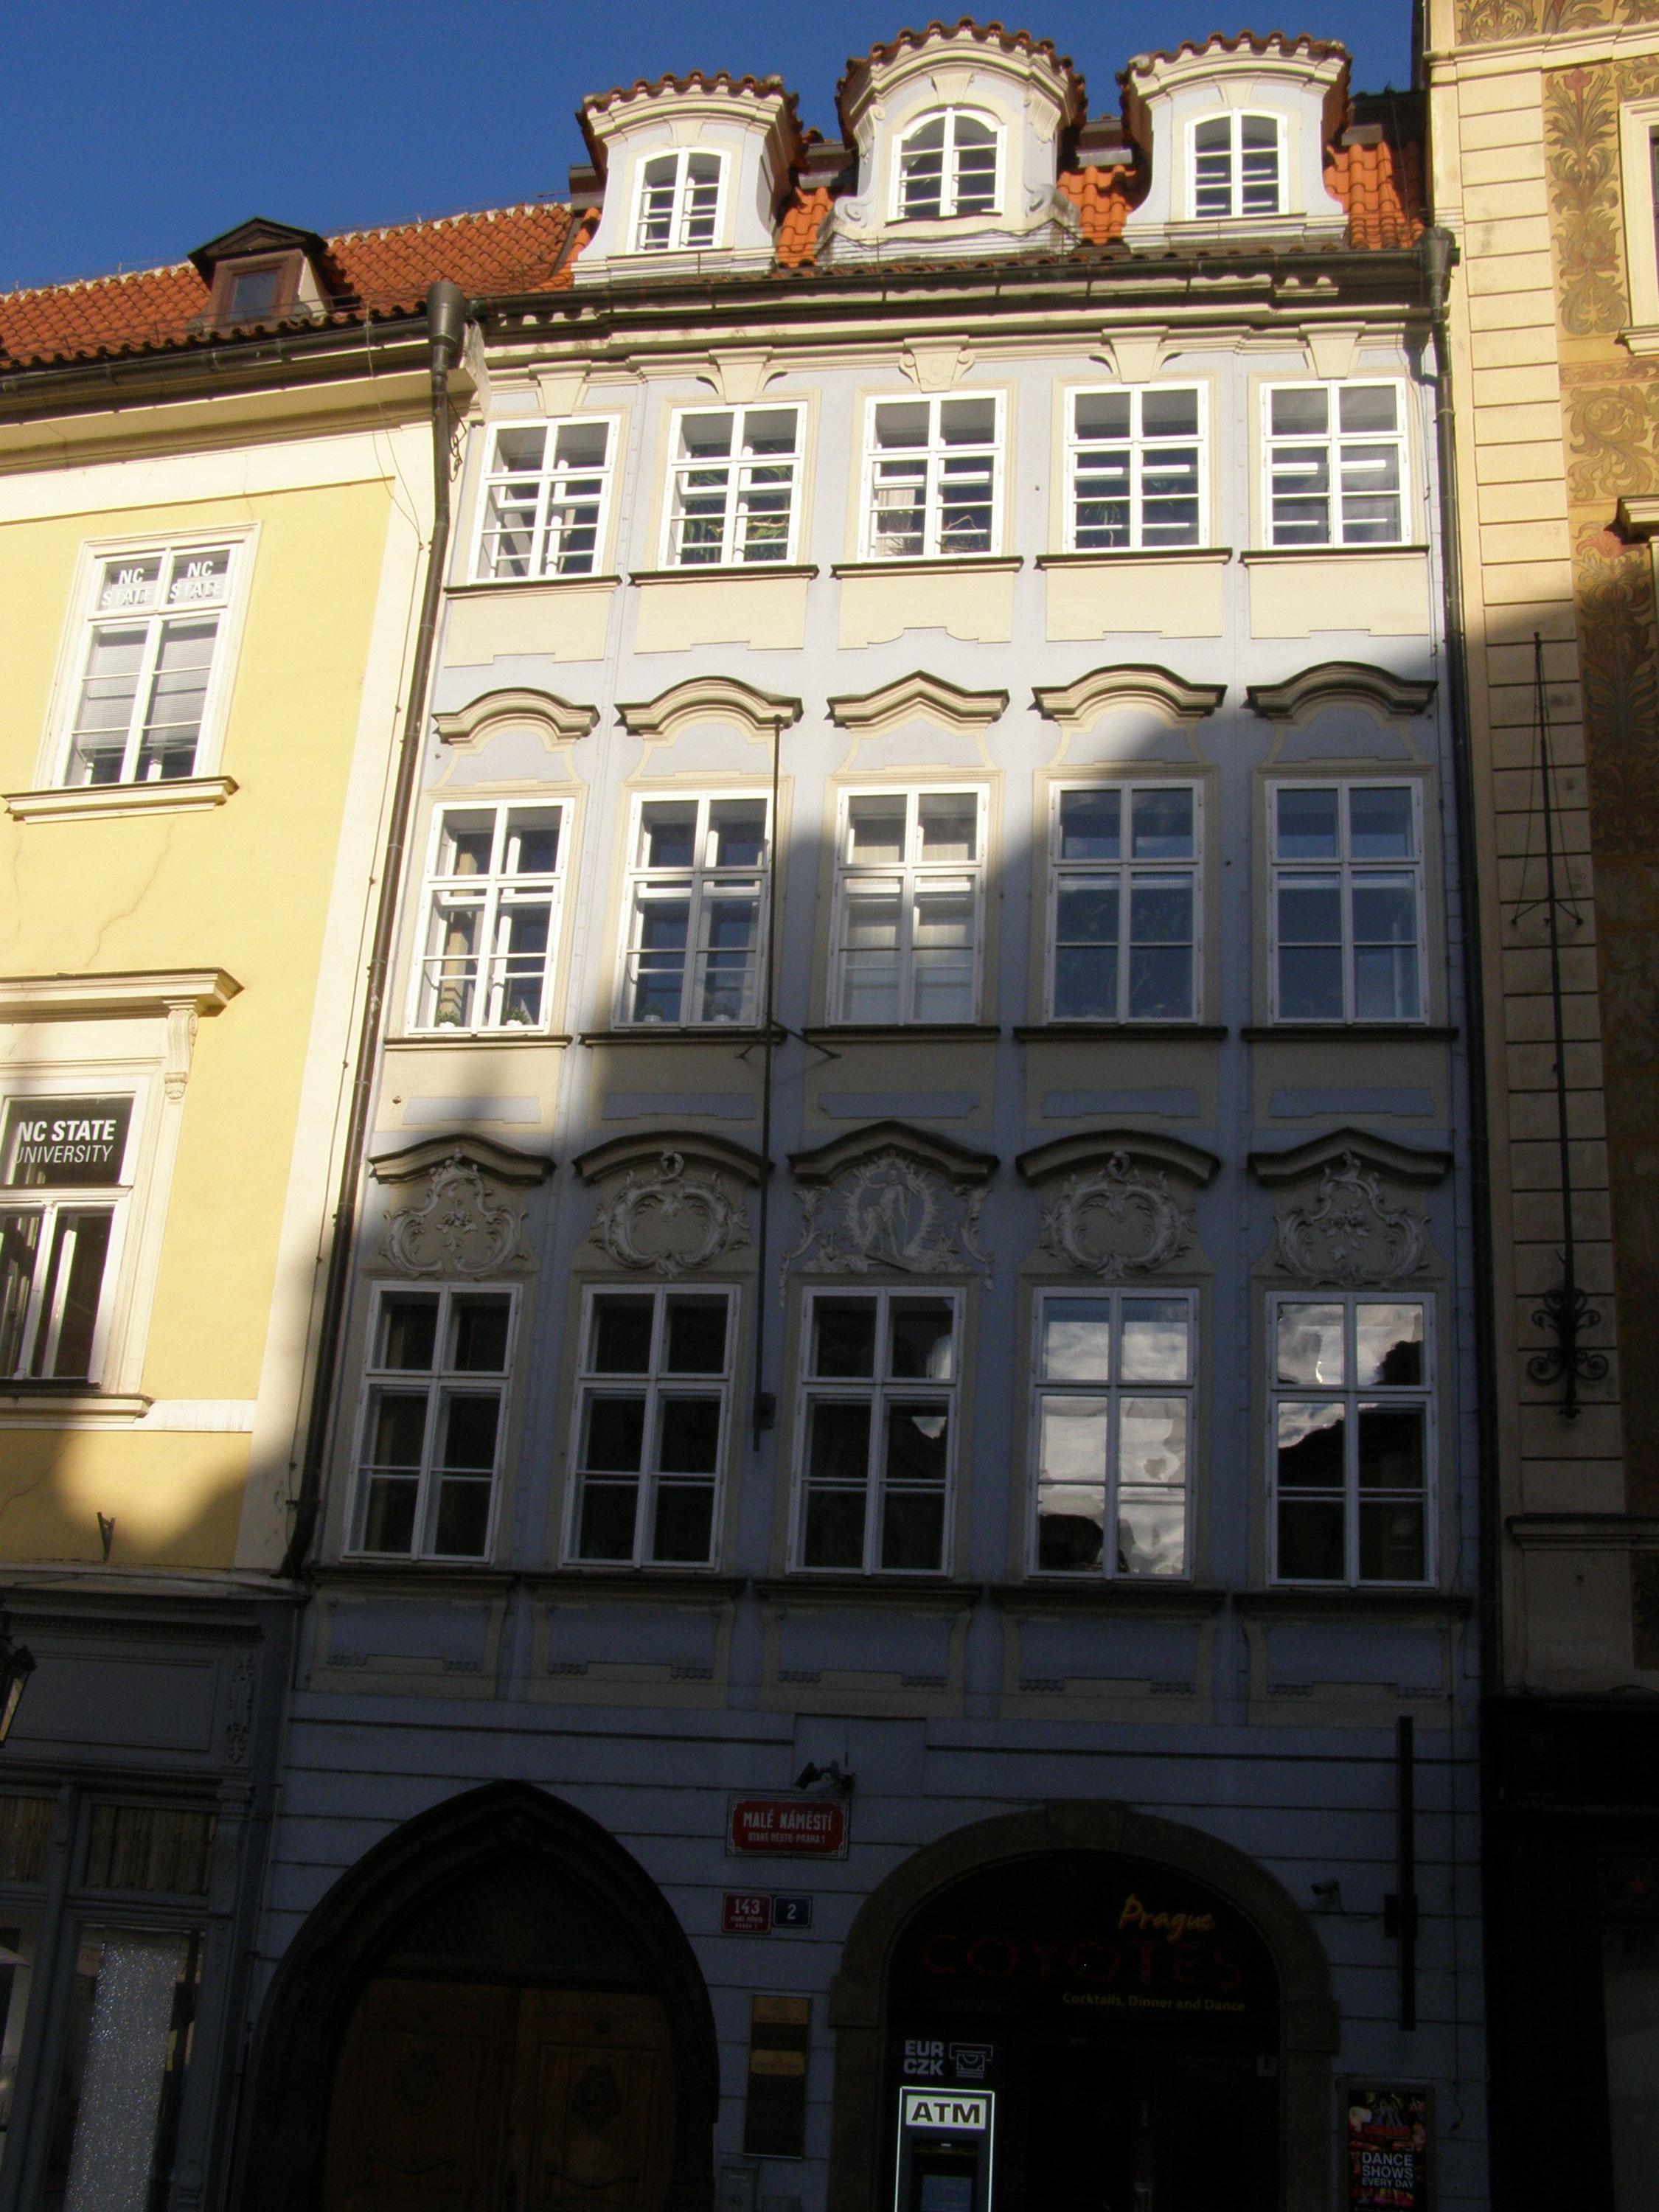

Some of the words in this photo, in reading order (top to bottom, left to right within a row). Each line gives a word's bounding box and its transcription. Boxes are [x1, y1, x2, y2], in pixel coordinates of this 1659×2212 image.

[118, 568, 145, 585] NC
[187, 560, 214, 578] NC
[17, 1121, 48, 1142] NC
[51, 1119, 116, 1142] STATE
[15, 1145, 114, 1164] UNIVERSITY
[742, 1808, 773, 1829] MALÉ
[779, 1809, 833, 1832] NÁMĚSTÍ
[734, 1898, 760, 1915] 143
[787, 1903, 796, 1920] 2
[1118, 1892, 1217, 1944] Prague
[922, 1933, 1244, 1993] COYOTES
[1062, 1991, 1125, 2008] Cocktails,
[1127, 1994, 1174, 2008] Dinner
[1175, 1997, 1201, 2010] and
[1204, 1998, 1246, 2012] Dance
[903, 2039, 944, 2057] EUR
[903, 2057, 944, 2076] CZK
[911, 2101, 980, 2124] ATM
[1361, 2151, 1413, 2167] DANCE
[1361, 2165, 1414, 2180] SHOWS
[1361, 2178, 1394, 2188] EVERY
[1394, 2180, 1415, 2189] DAY
